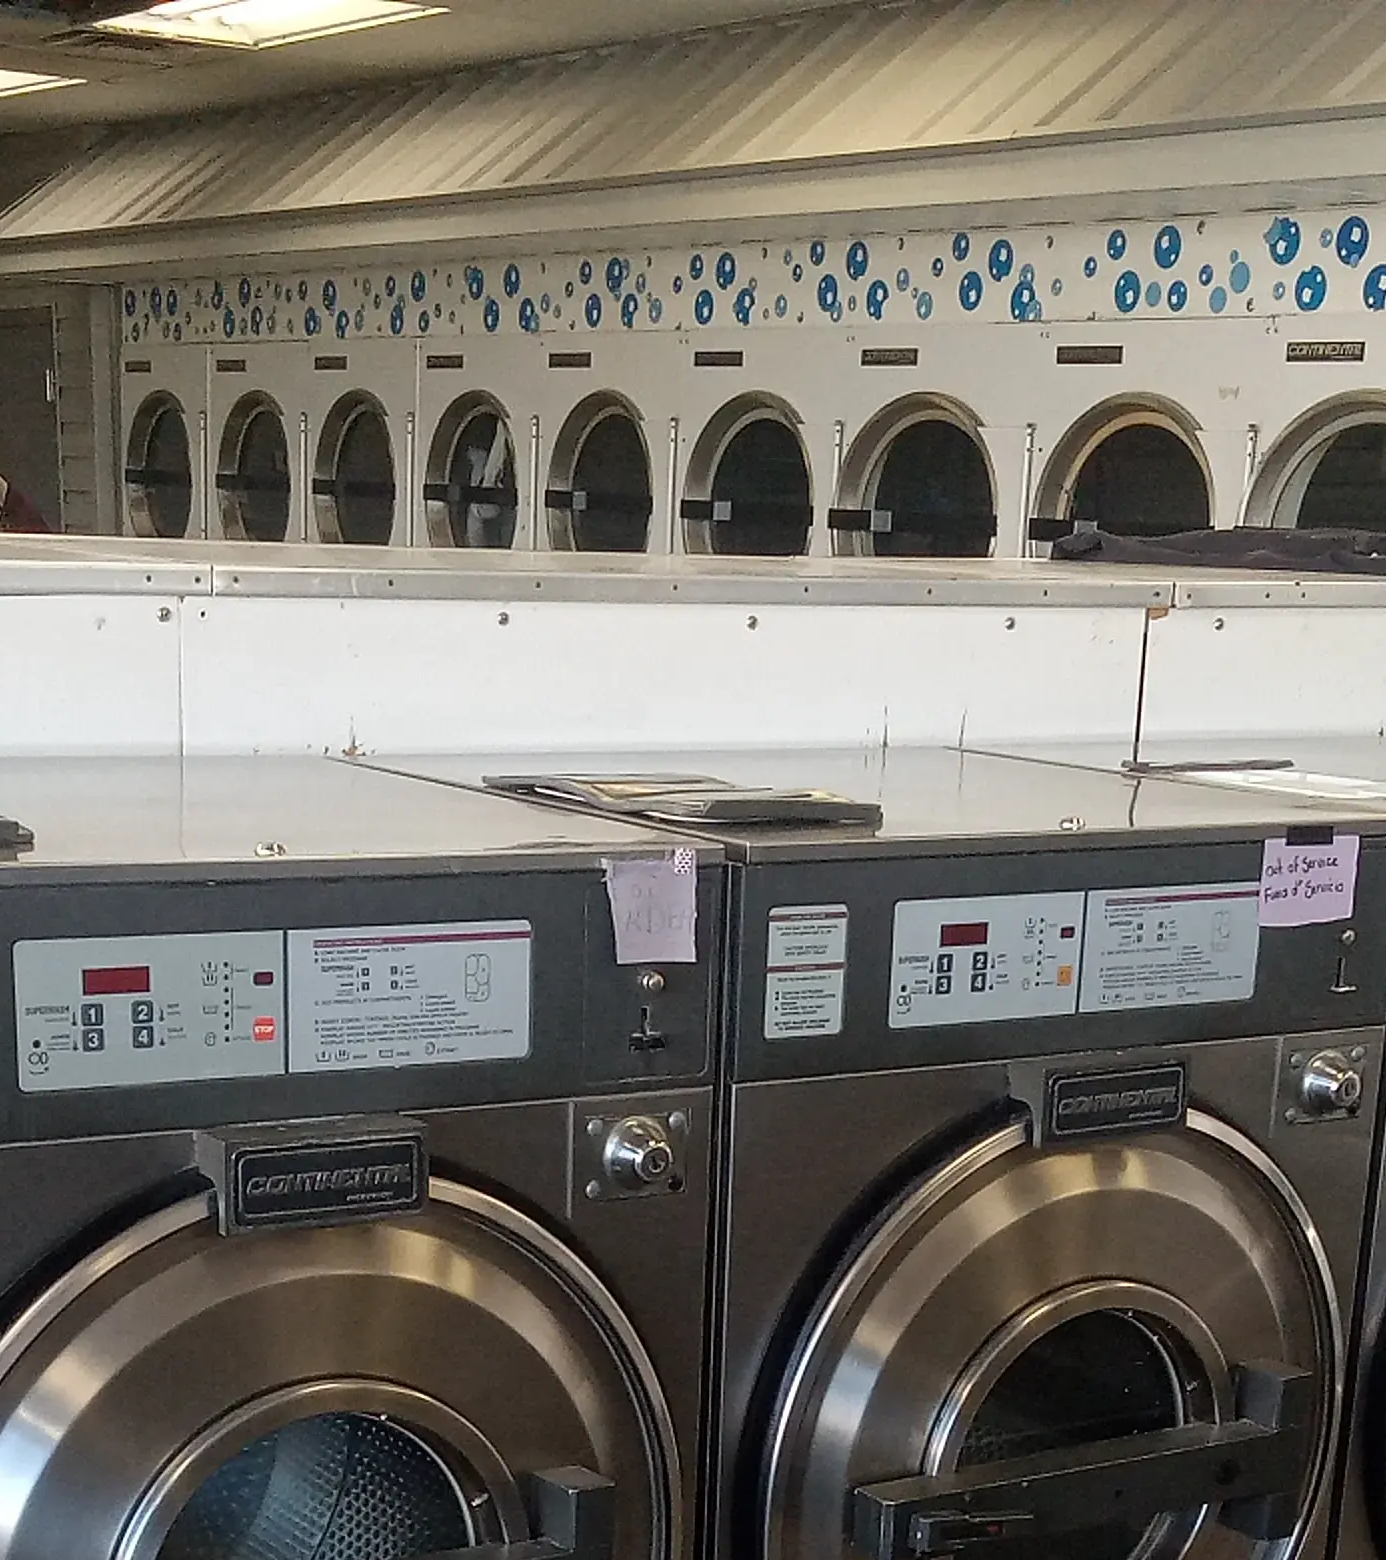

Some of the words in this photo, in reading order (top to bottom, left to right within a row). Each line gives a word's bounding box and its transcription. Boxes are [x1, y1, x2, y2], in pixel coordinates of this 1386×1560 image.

[1265, 857, 1283, 877] Out
[1287, 855, 1300, 872] of
[1301, 856, 1339, 873] Service
[941, 956, 949, 970] 1
[976, 955, 986, 968] 2
[939, 978, 948, 992] 3
[973, 976, 983, 989] 4
[87, 1007, 97, 1023] 1
[137, 1004, 149, 1020] 2
[137, 1029, 150, 1045] 4
[254, 1025, 275, 1035] STOP
[88, 1031, 99, 1048] 3
[246, 1162, 411, 1197] CONTINENTAL
